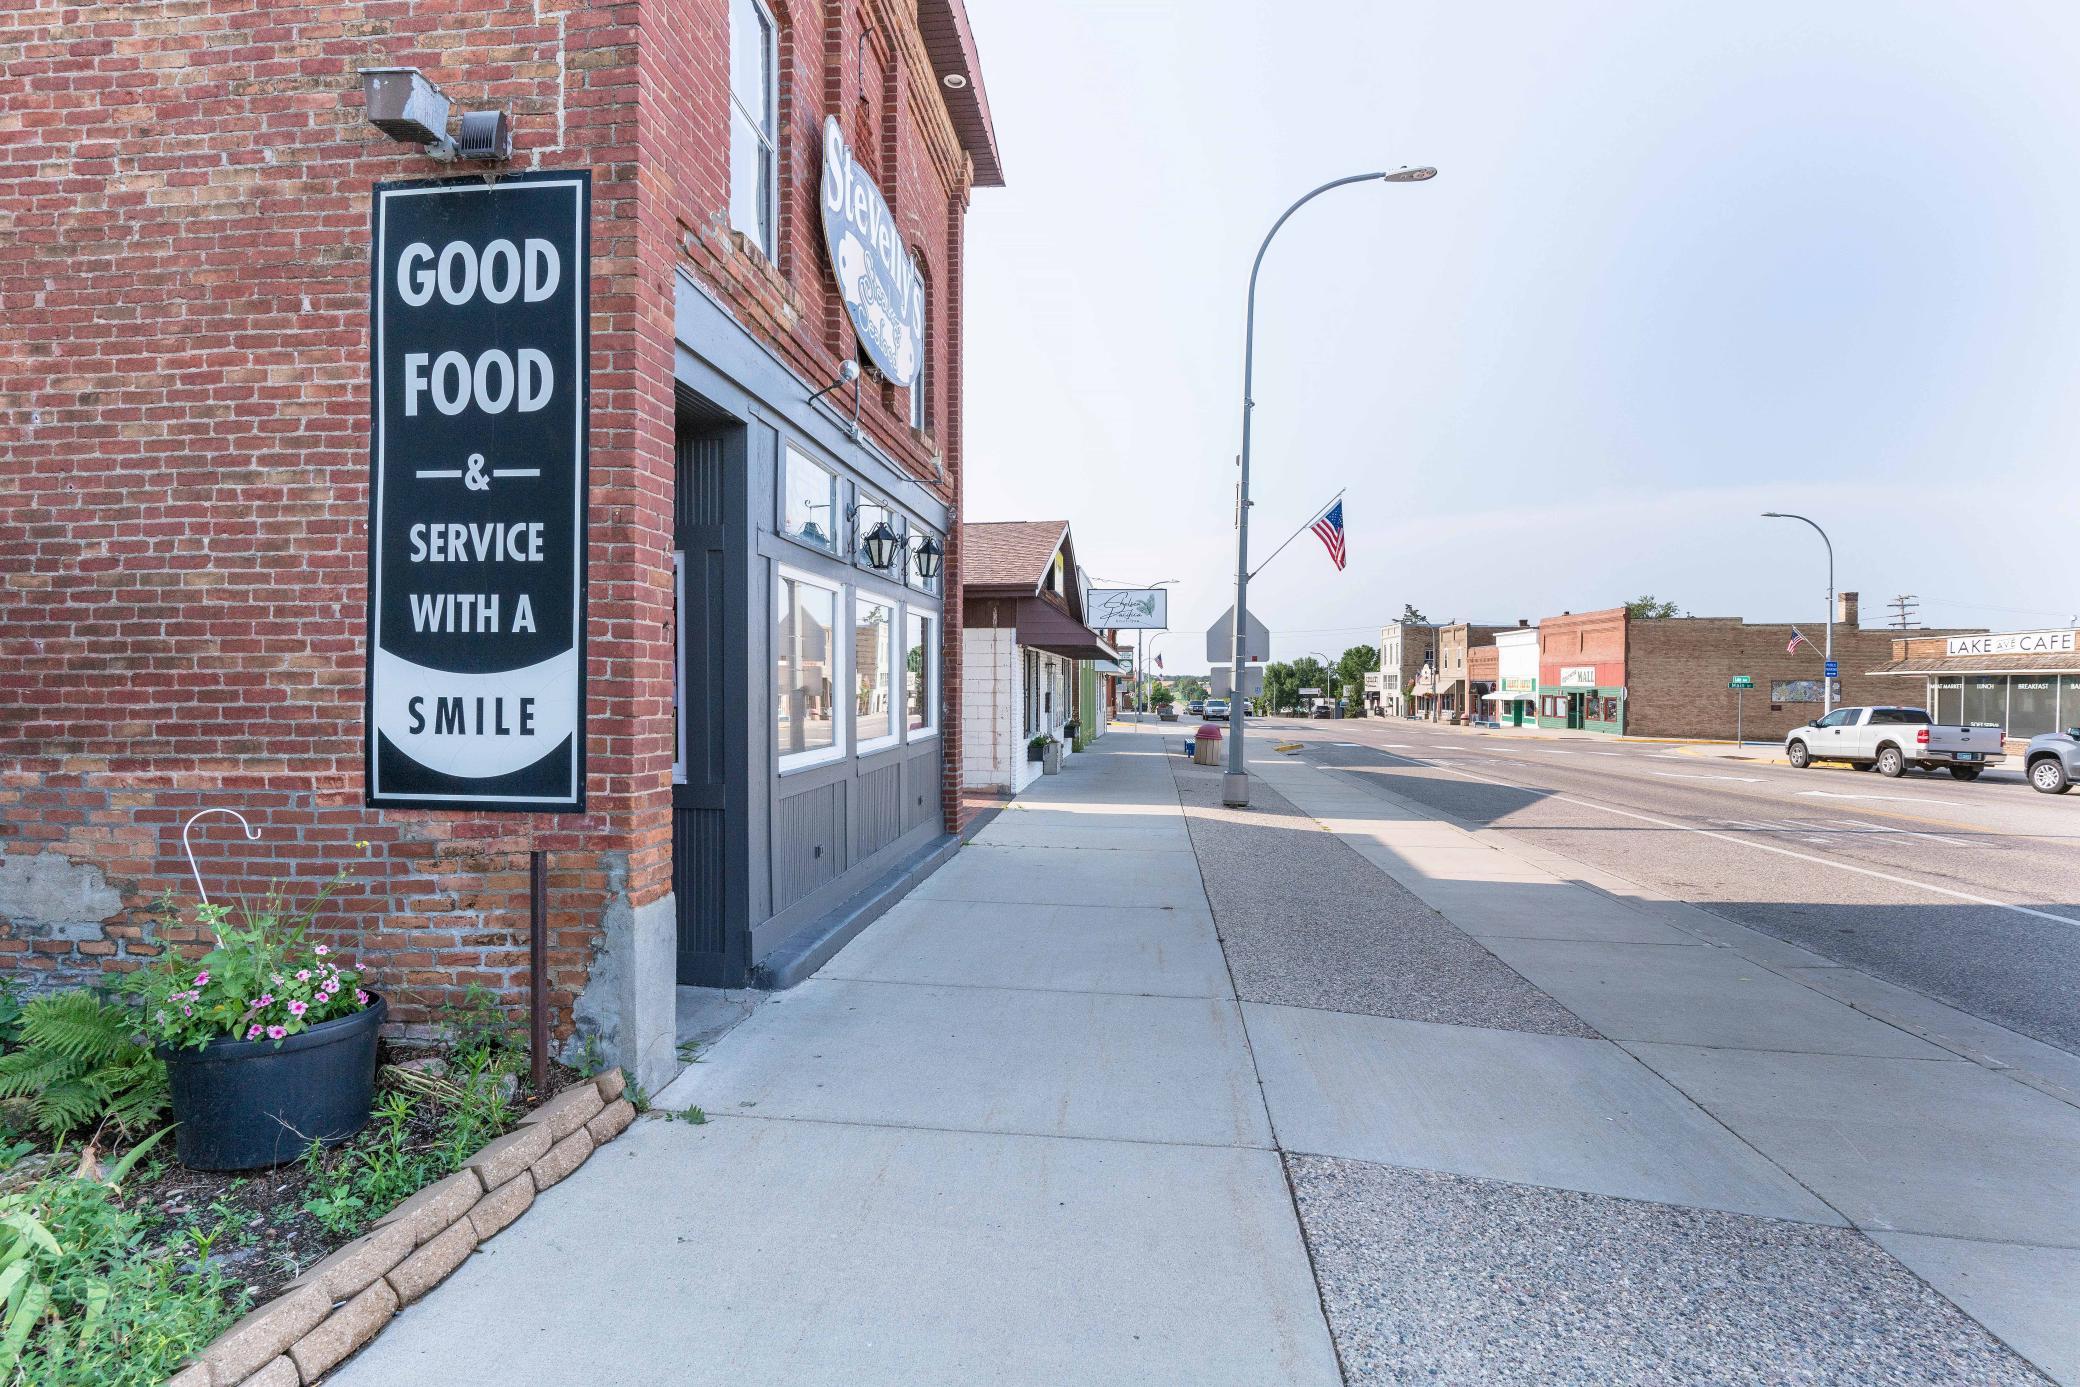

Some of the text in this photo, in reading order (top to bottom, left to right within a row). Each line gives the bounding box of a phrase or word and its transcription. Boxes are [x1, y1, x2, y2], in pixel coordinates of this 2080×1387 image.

[397, 238, 561, 307] GOOD
[404, 348, 554, 417] FOOD
[464, 453, 490, 491] &
[409, 522, 544, 563] SERVICE
[409, 593, 537, 633] WITH A
[1950, 634, 2071, 654] LAKE AVE CAFE
[1577, 671, 1595, 683] MALL
[408, 695, 535, 736] SMILE
